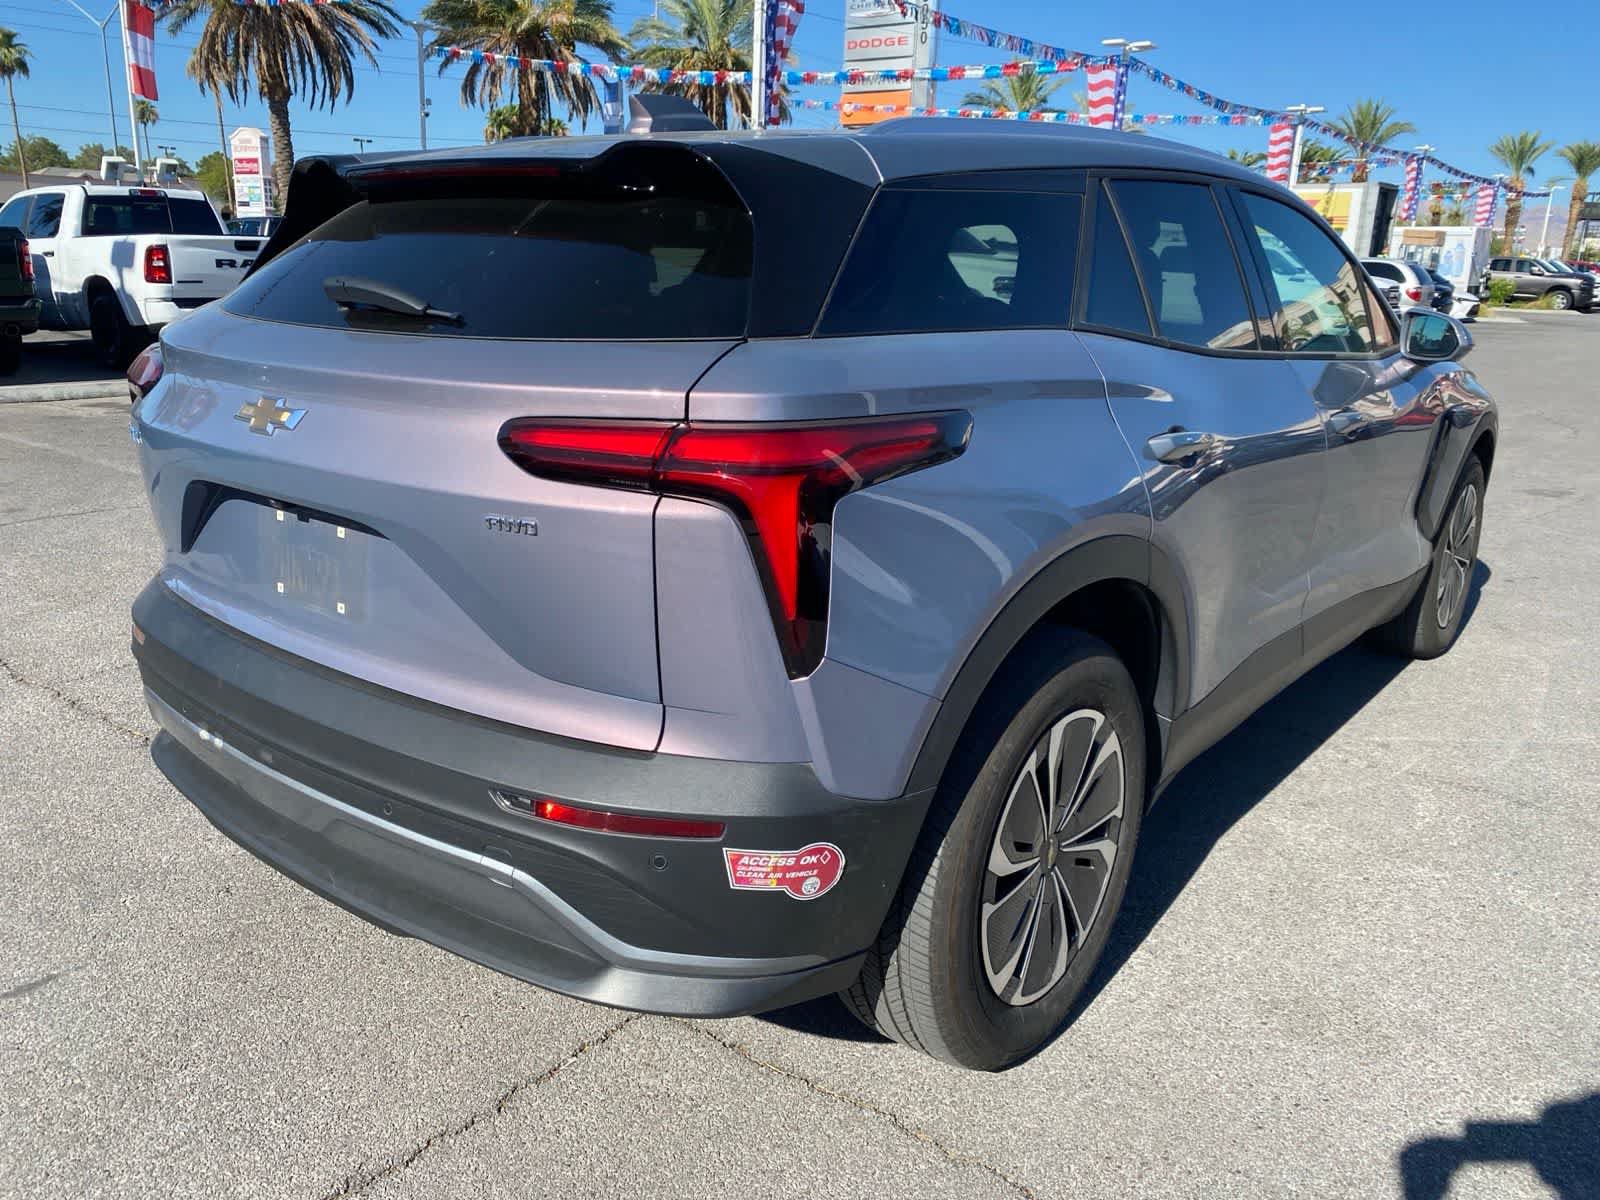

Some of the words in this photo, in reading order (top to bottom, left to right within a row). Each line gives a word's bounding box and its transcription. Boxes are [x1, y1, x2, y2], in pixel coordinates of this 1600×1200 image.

[847, 36, 909, 50] DODGE
[215, 258, 254, 269] RA
[738, 855, 796, 867] ACCESS
[800, 854, 820, 865] OK
[736, 870, 765, 879] CLEAN
[785, 869, 818, 878] VEHICLE
